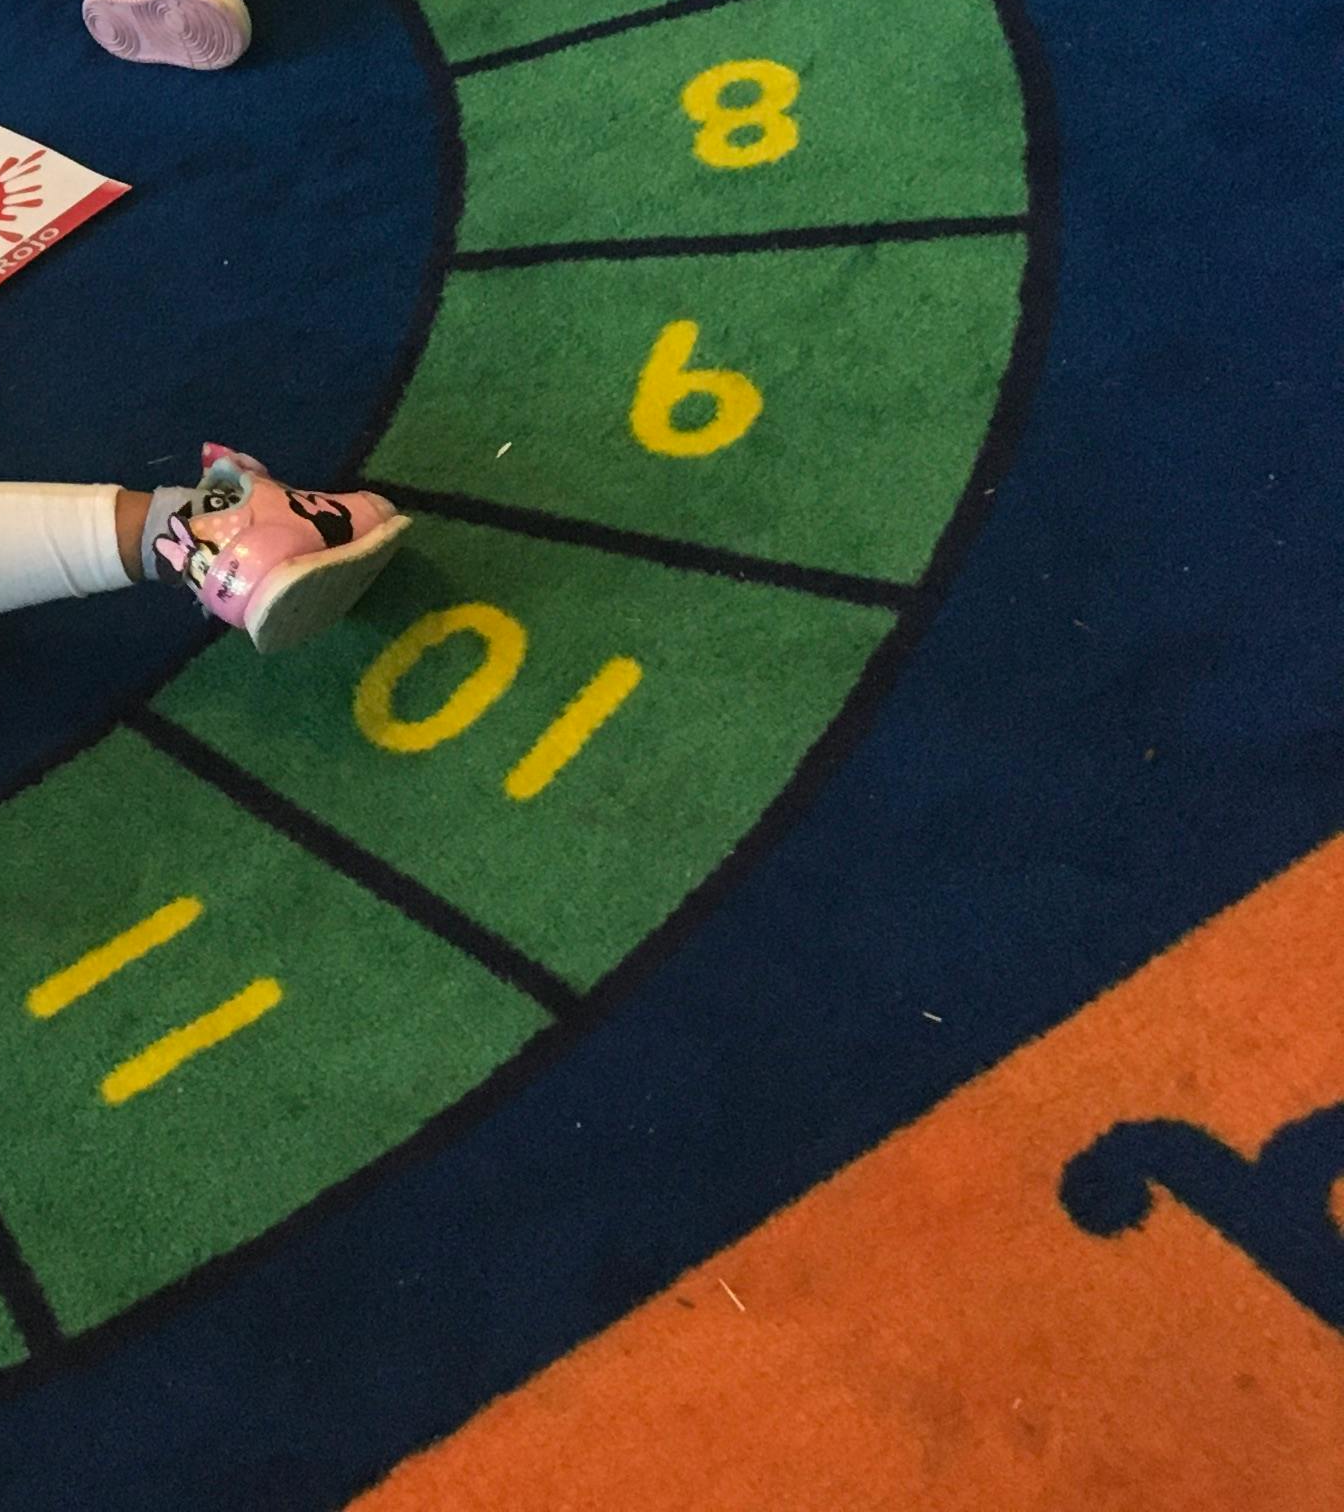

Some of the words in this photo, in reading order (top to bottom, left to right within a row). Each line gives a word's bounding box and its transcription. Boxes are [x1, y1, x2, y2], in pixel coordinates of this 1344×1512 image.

[680, 58, 801, 169] 8
[628, 319, 764, 458] 9
[352, 602, 643, 802] 10
[24, 896, 284, 1107] 11
